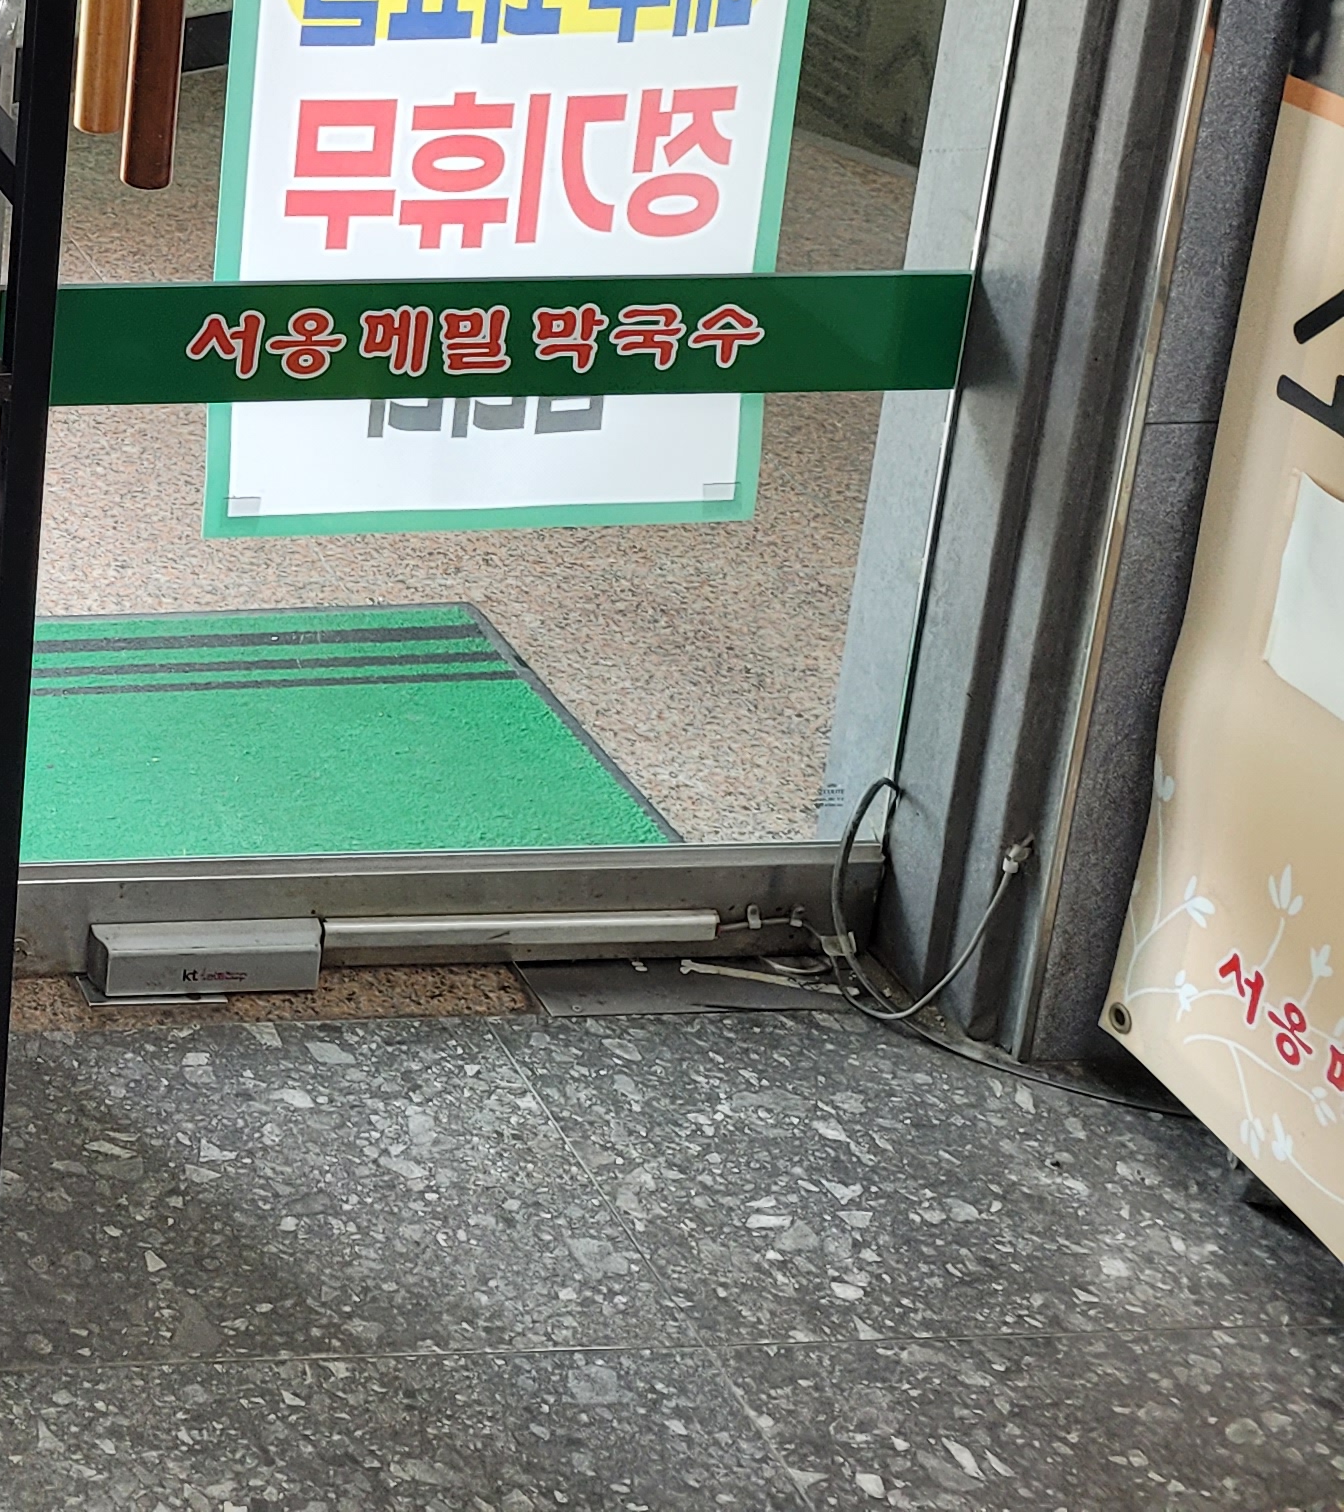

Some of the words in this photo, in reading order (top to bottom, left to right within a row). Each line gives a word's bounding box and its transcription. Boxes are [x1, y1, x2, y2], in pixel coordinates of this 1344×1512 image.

[184, 307, 347, 381] 서웅
[358, 305, 512, 376] 메밀
[531, 302, 766, 374] 막국수
